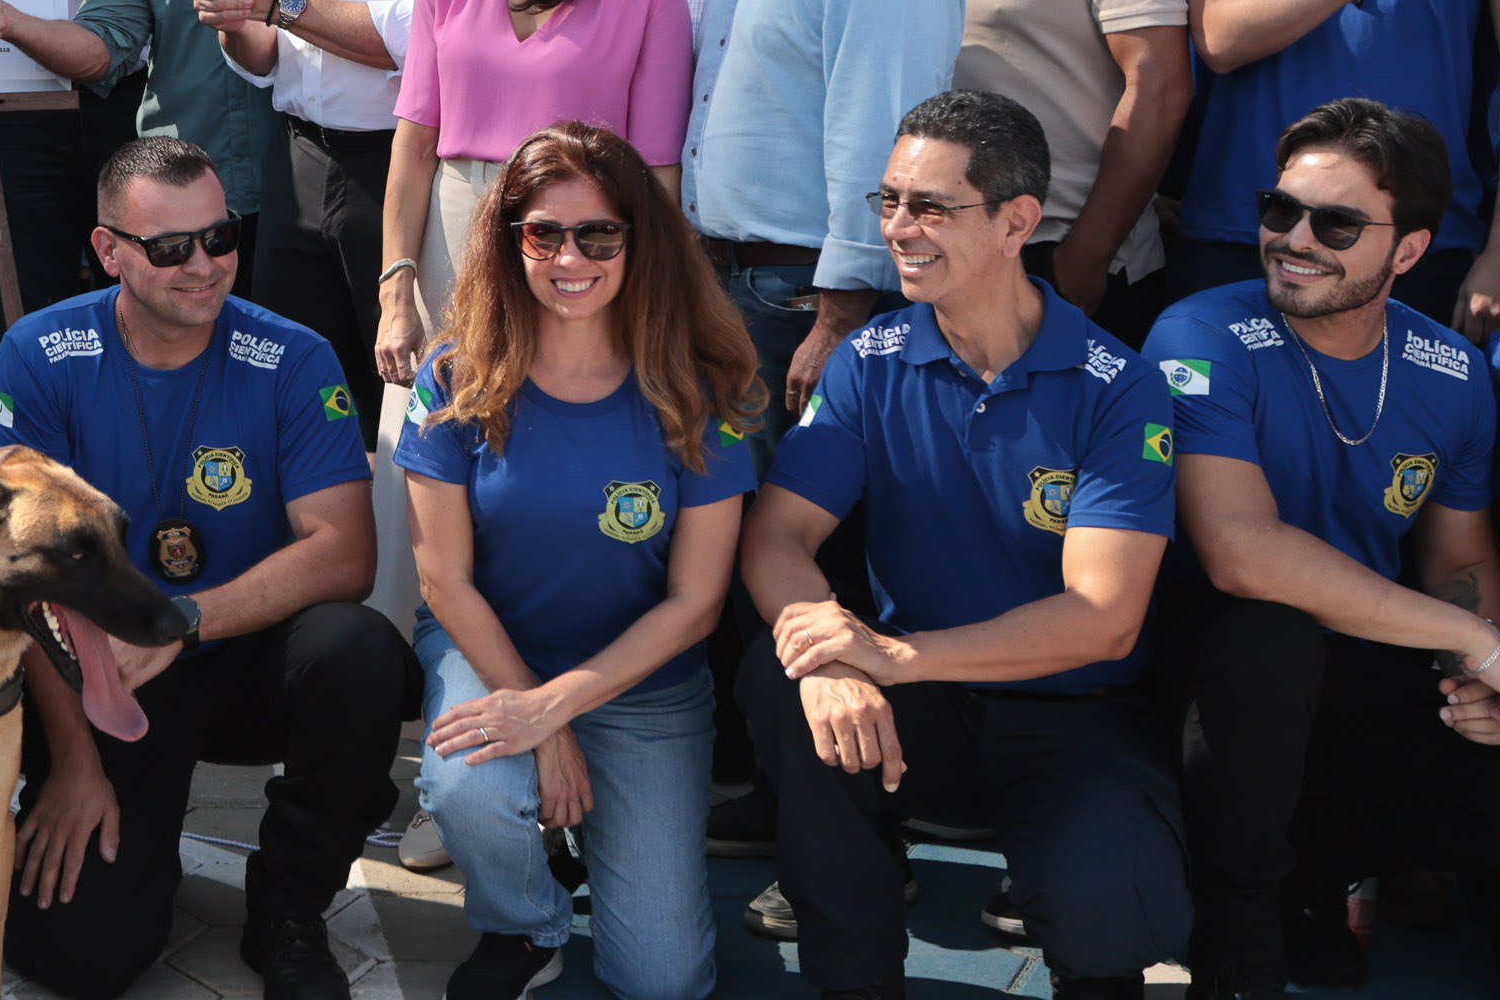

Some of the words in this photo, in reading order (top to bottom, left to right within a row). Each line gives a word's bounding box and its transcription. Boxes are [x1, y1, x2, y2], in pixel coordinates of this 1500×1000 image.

[38, 327, 99, 349] POLÍCIA
[45, 340, 102, 357] CIENTÍFICA
[231, 330, 286, 355] POLÍCIA
[49, 350, 70, 364] PARAN
[230, 340, 281, 364] CIENTÍFICA
